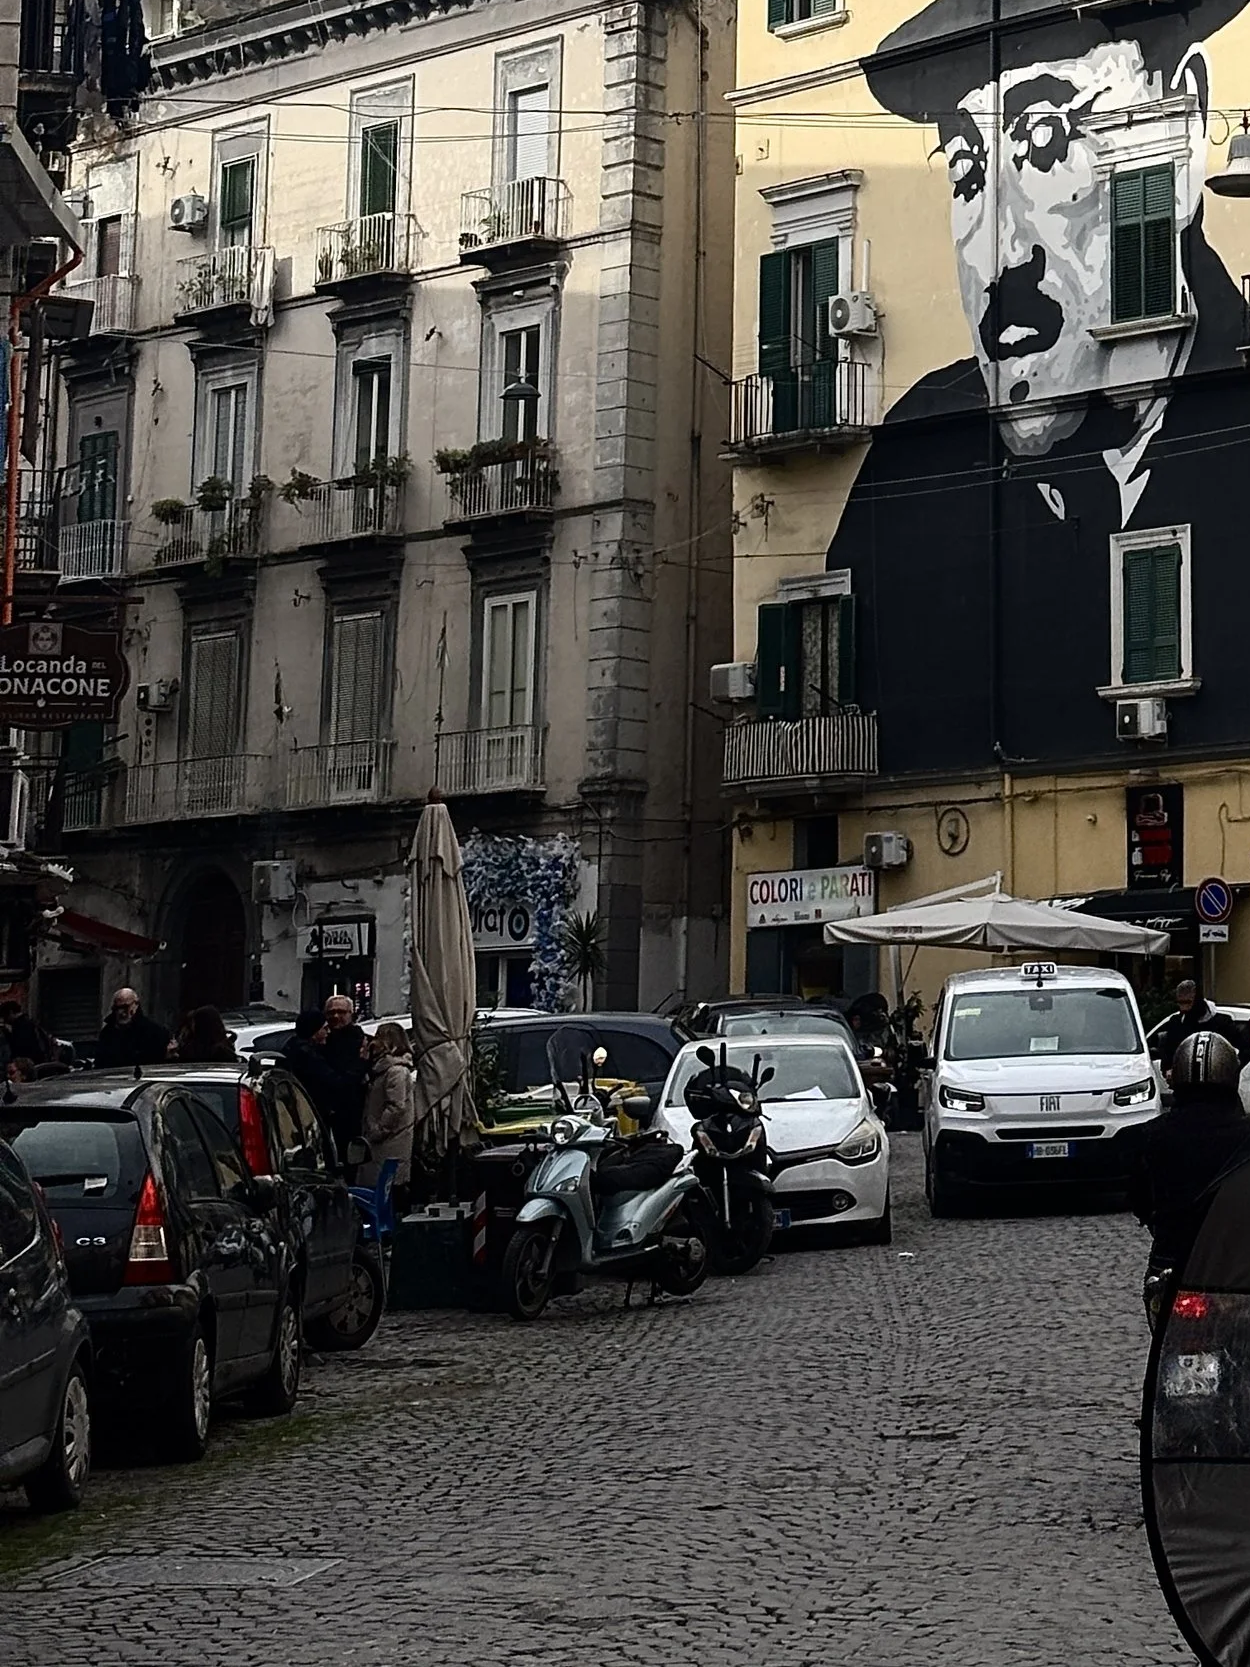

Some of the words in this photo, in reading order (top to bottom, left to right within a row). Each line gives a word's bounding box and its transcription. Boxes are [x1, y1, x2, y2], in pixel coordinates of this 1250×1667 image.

[0, 655, 87, 674] Locanda
[750, 877, 804, 905] COLORI
[807, 884, 817, 901] e
[820, 872, 873, 900] PARATI
[1024, 965, 1054, 975] TAXI
[1039, 1095, 1061, 1111] FIAT
[75, 1236, 107, 1247] C3
